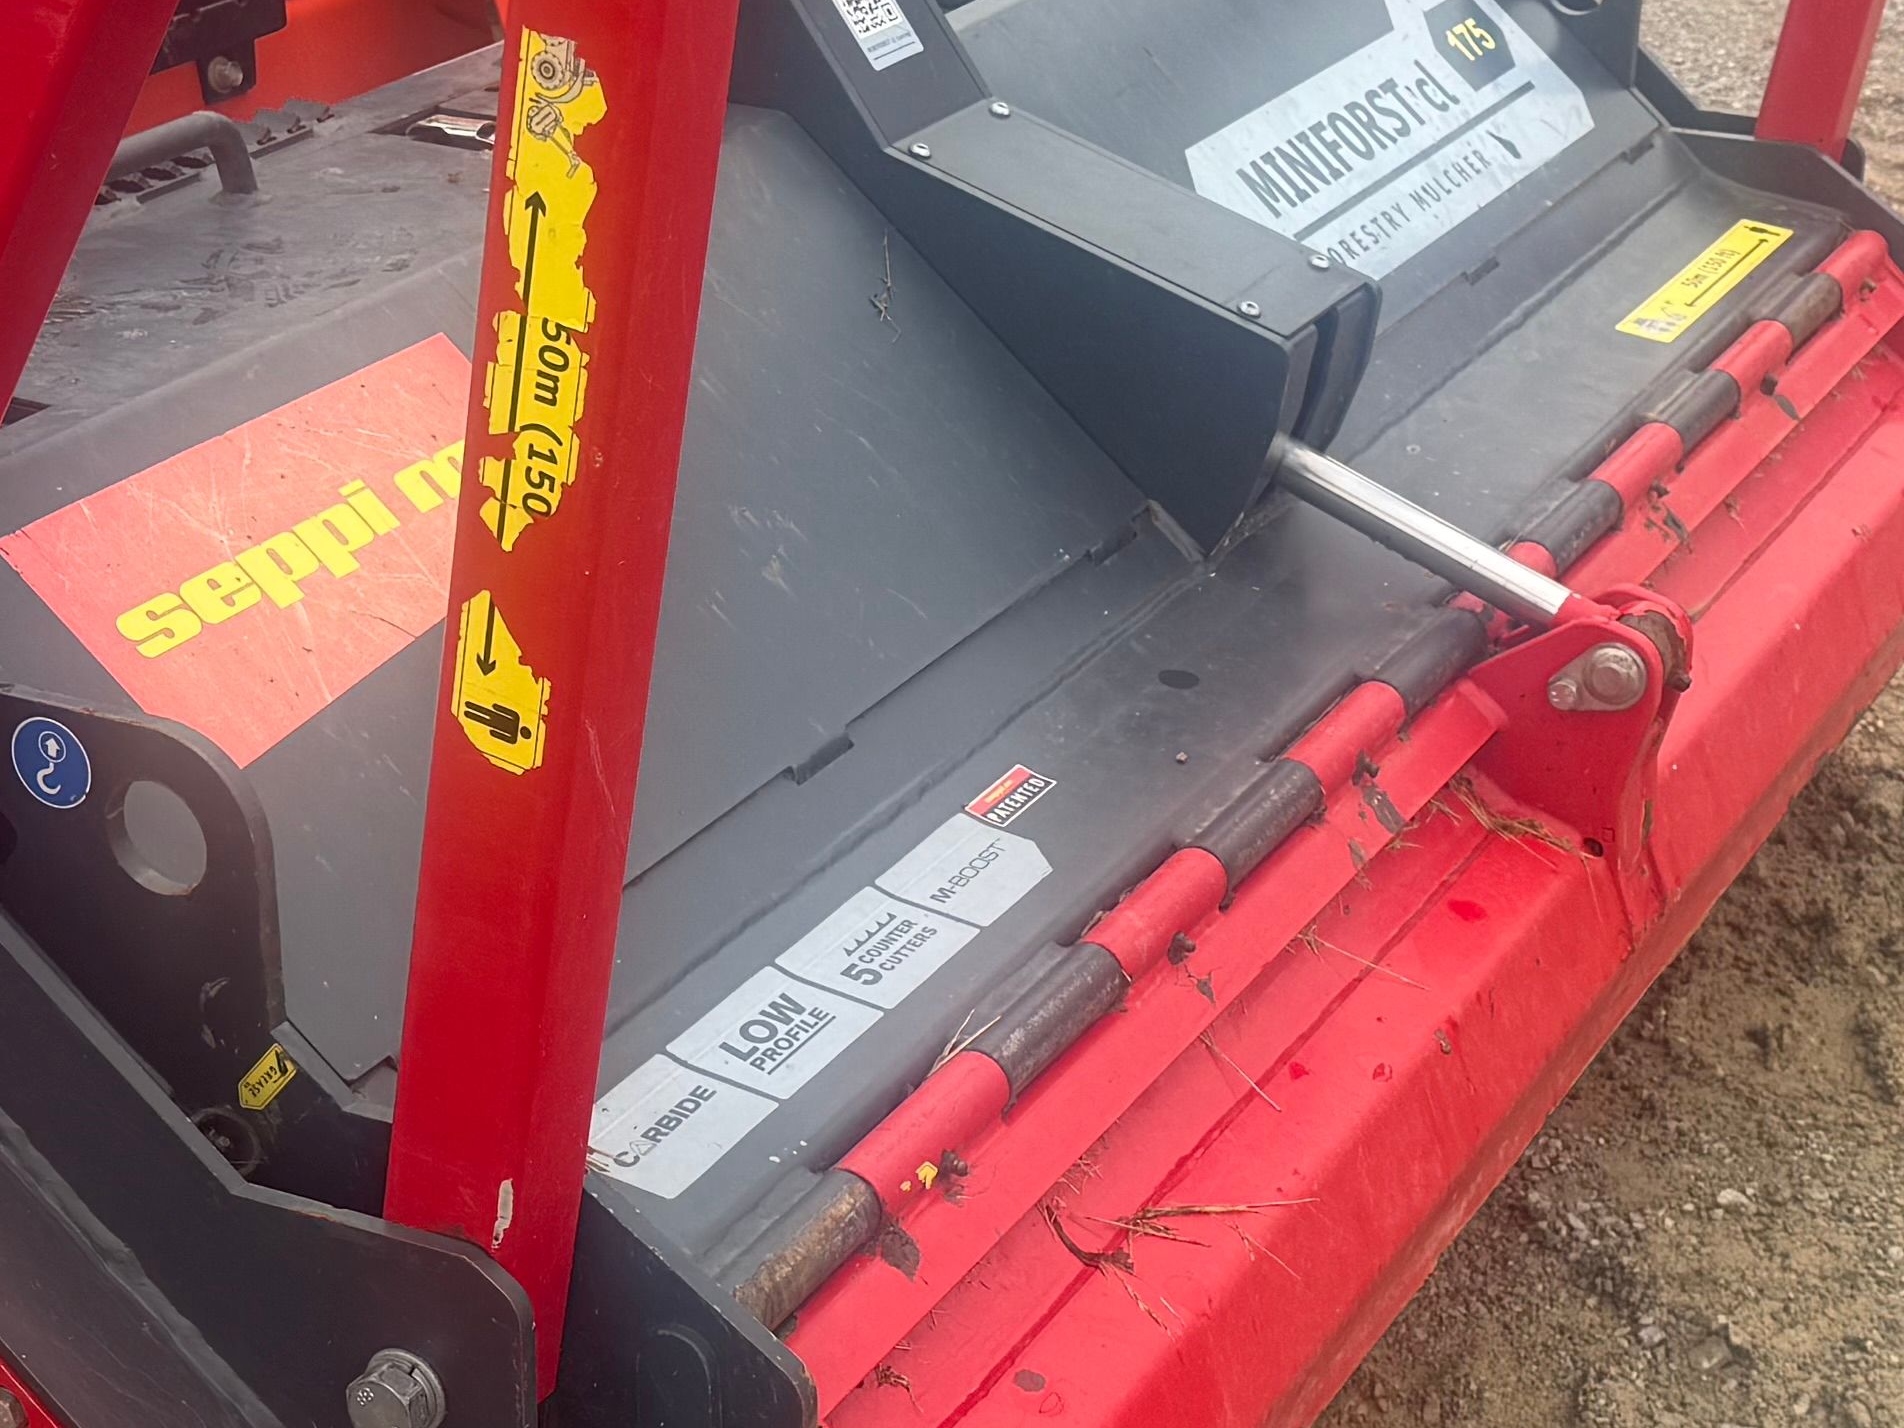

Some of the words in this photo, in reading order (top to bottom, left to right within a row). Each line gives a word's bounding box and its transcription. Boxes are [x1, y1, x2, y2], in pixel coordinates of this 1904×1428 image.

[1446, 17, 1496, 61] 175
[1235, 77, 1426, 219] MINIFORST
[1326, 201, 1413, 266] ORESTRY
[1411, 149, 1491, 212] MULCHER
[534, 316, 572, 408] 50m
[115, 478, 401, 659] seppi
[985, 777, 1046, 823] PATENTED
[857, 918, 919, 965] COUNTER
[878, 925, 938, 972] CUTTERS
[840, 962, 884, 986] 5
[718, 992, 808, 1063] LOW
[749, 1006, 831, 1072] PROFILE
[248, 1065, 279, 1098] GREASE
